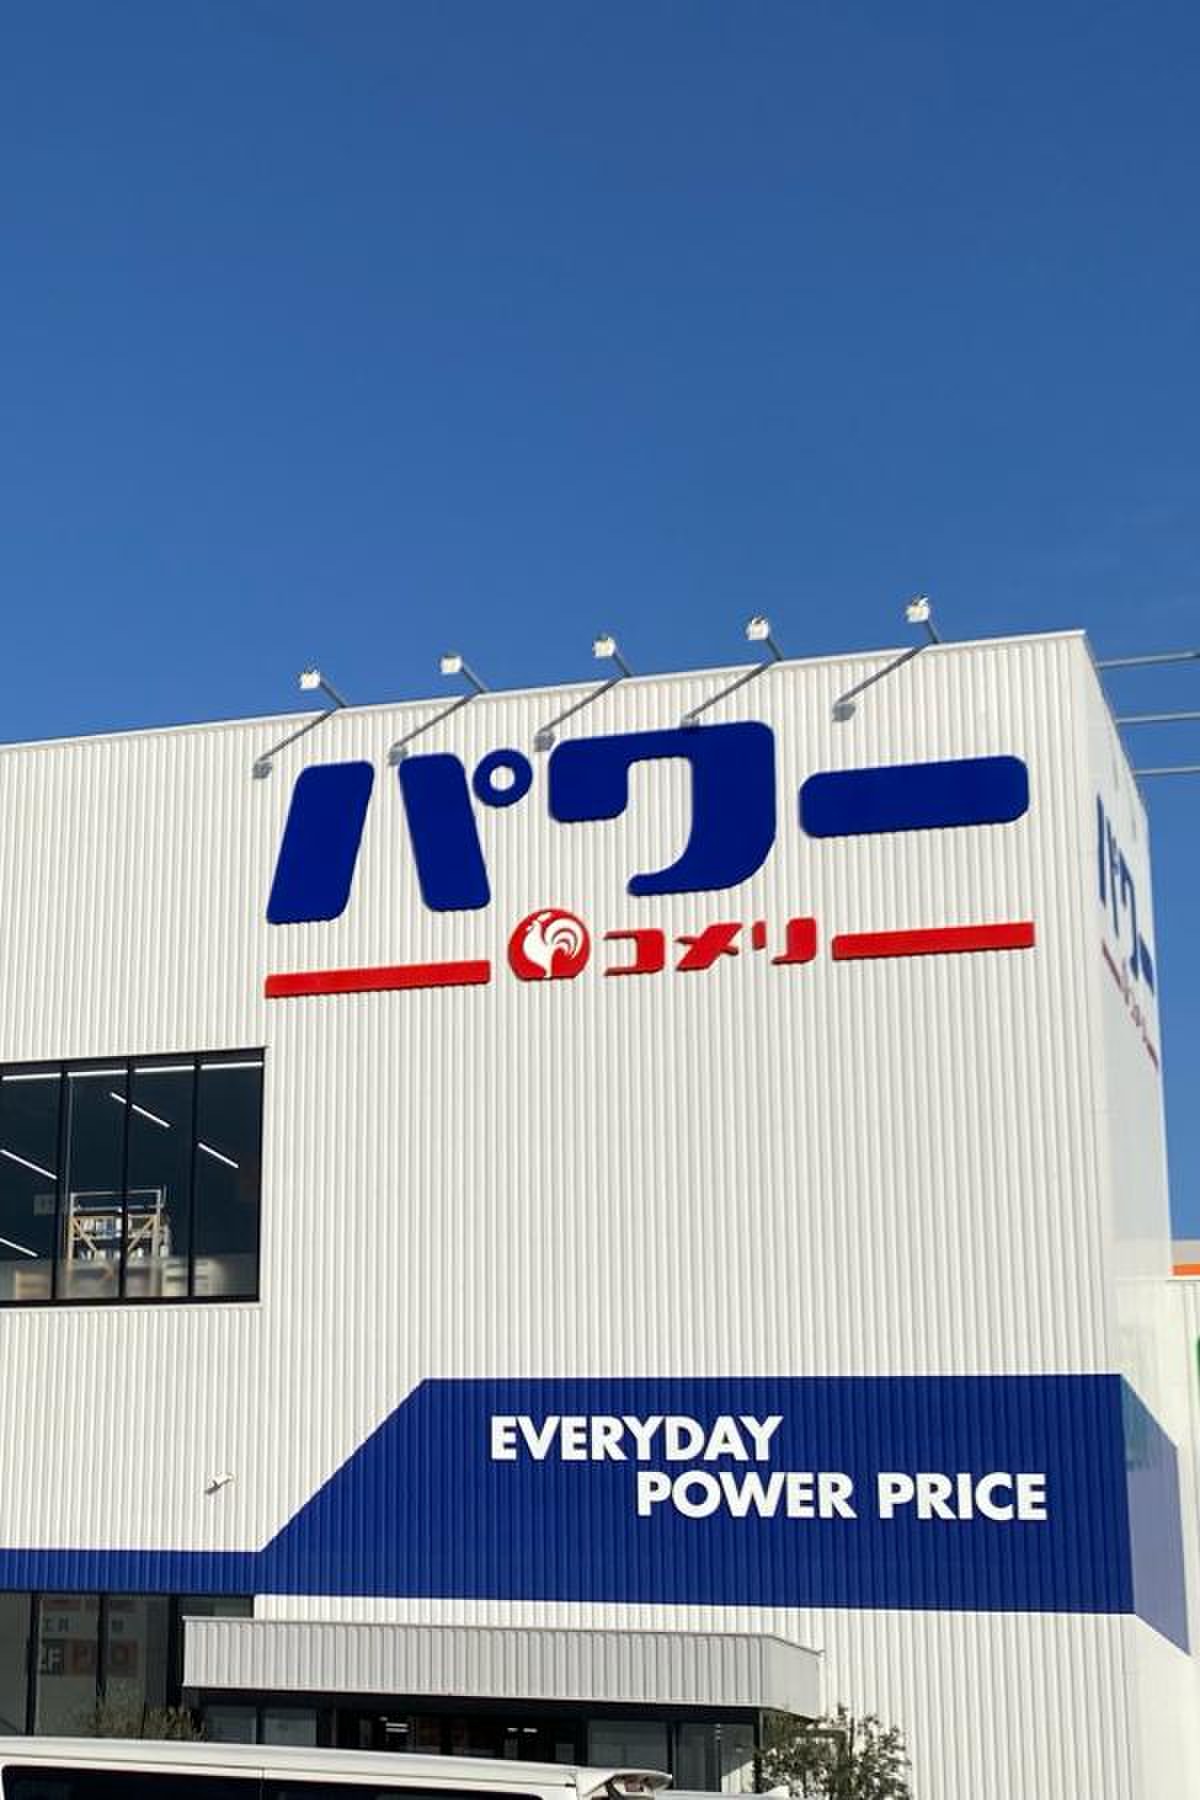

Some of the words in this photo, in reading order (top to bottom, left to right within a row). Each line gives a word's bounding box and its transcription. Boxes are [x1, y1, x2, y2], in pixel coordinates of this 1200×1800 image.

[266, 720, 1030, 924] パワー
[603, 917, 817, 976] コメリ
[490, 1415, 783, 1461] EVERYDAY
[636, 1470, 857, 1519] POWER
[877, 1472, 1048, 1521] PRICE
